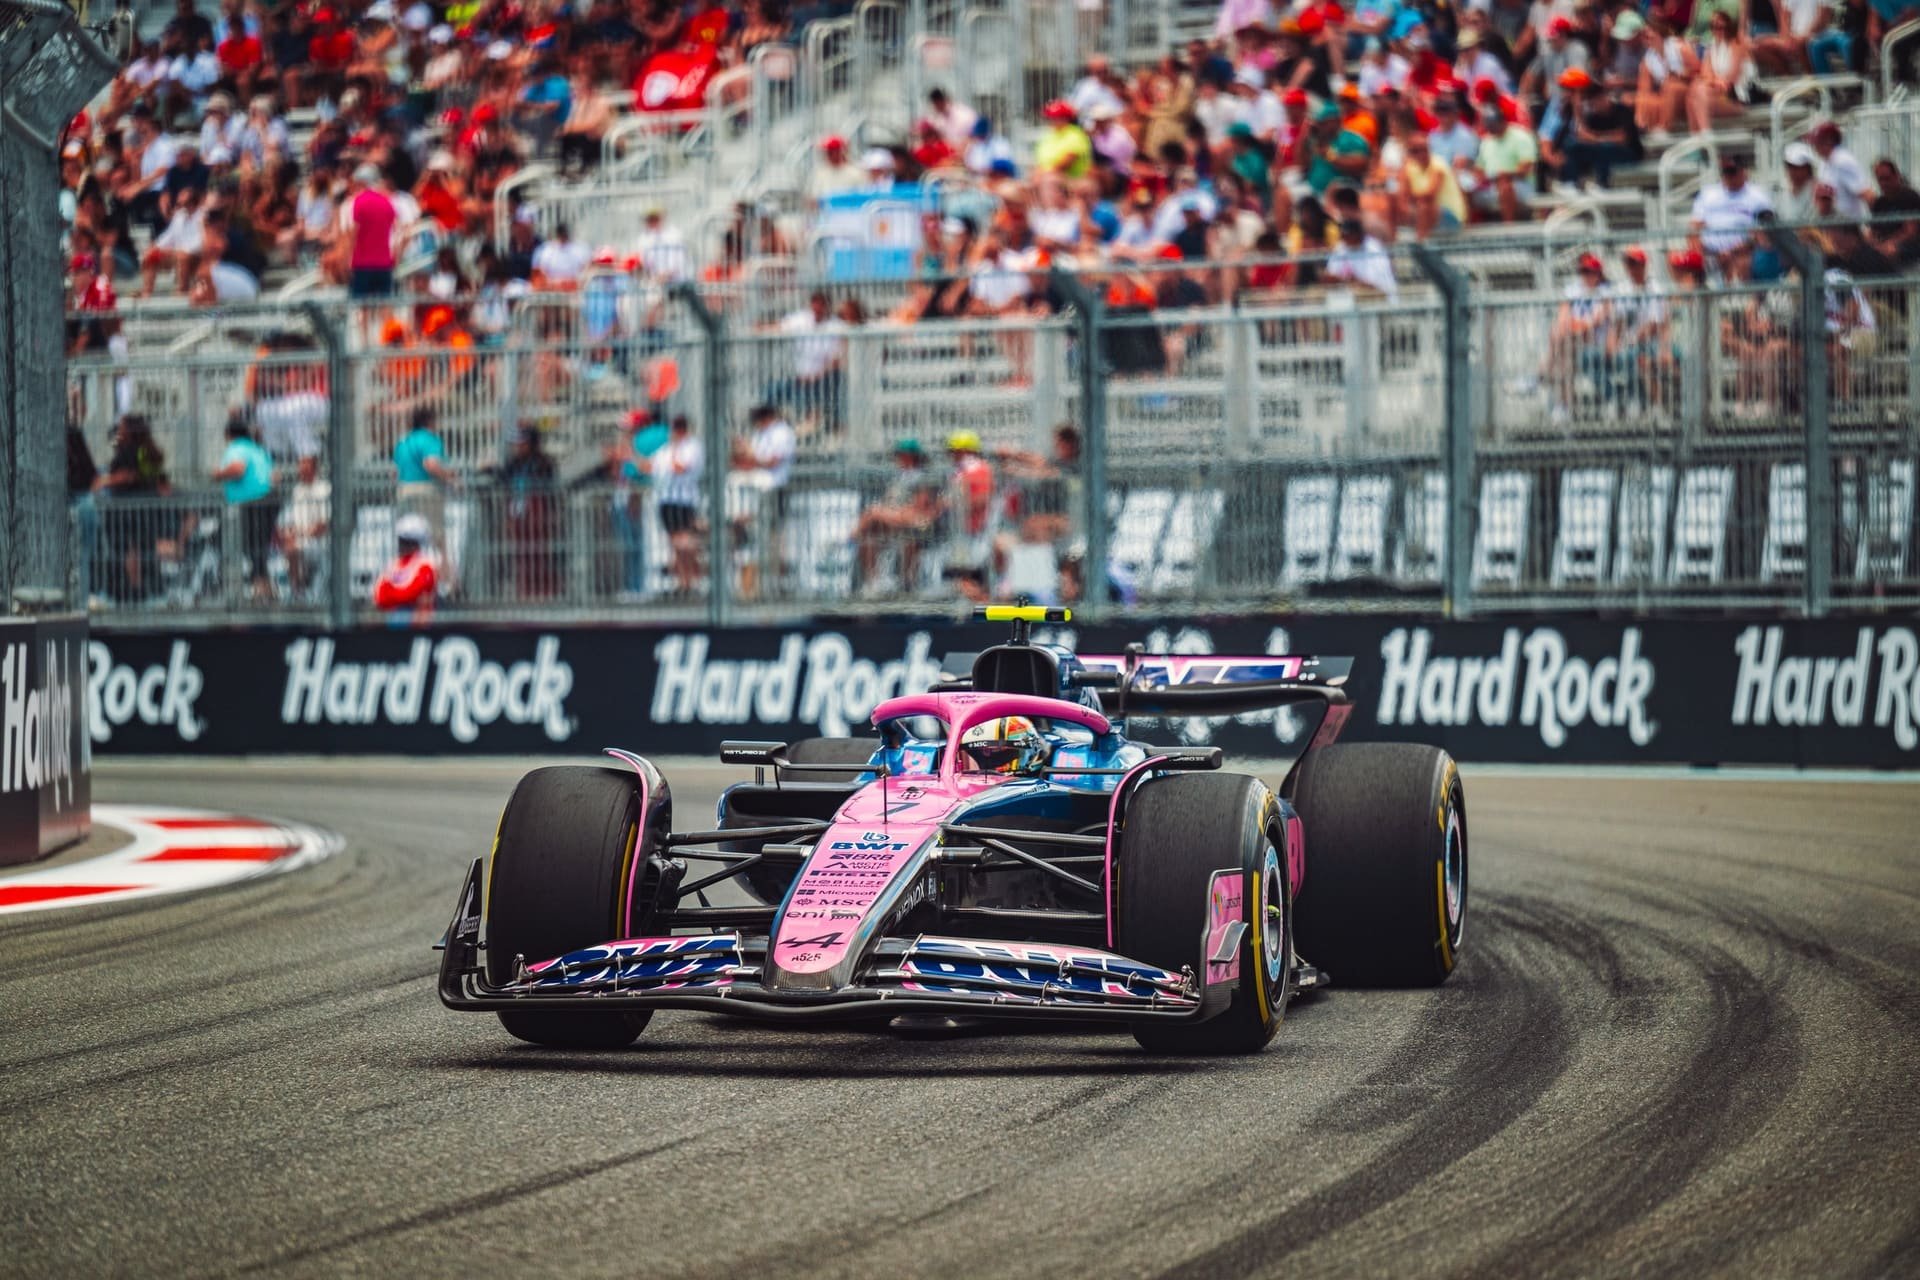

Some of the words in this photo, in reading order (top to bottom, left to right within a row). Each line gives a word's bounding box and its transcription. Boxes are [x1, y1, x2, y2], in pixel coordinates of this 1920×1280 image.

[89, 640, 204, 742] Rock
[282, 636, 431, 724] Hard
[430, 636, 574, 743] Rock
[650, 633, 805, 723] Hard
[1376, 627, 1521, 726] Hard
[1519, 627, 1656, 748] Rock
[1731, 626, 1875, 726] Hard
[830, 842, 909, 851] BWT
[876, 801, 921, 817] 7
[786, 910, 826, 919] eni
[818, 889, 878, 897] Microsoft
